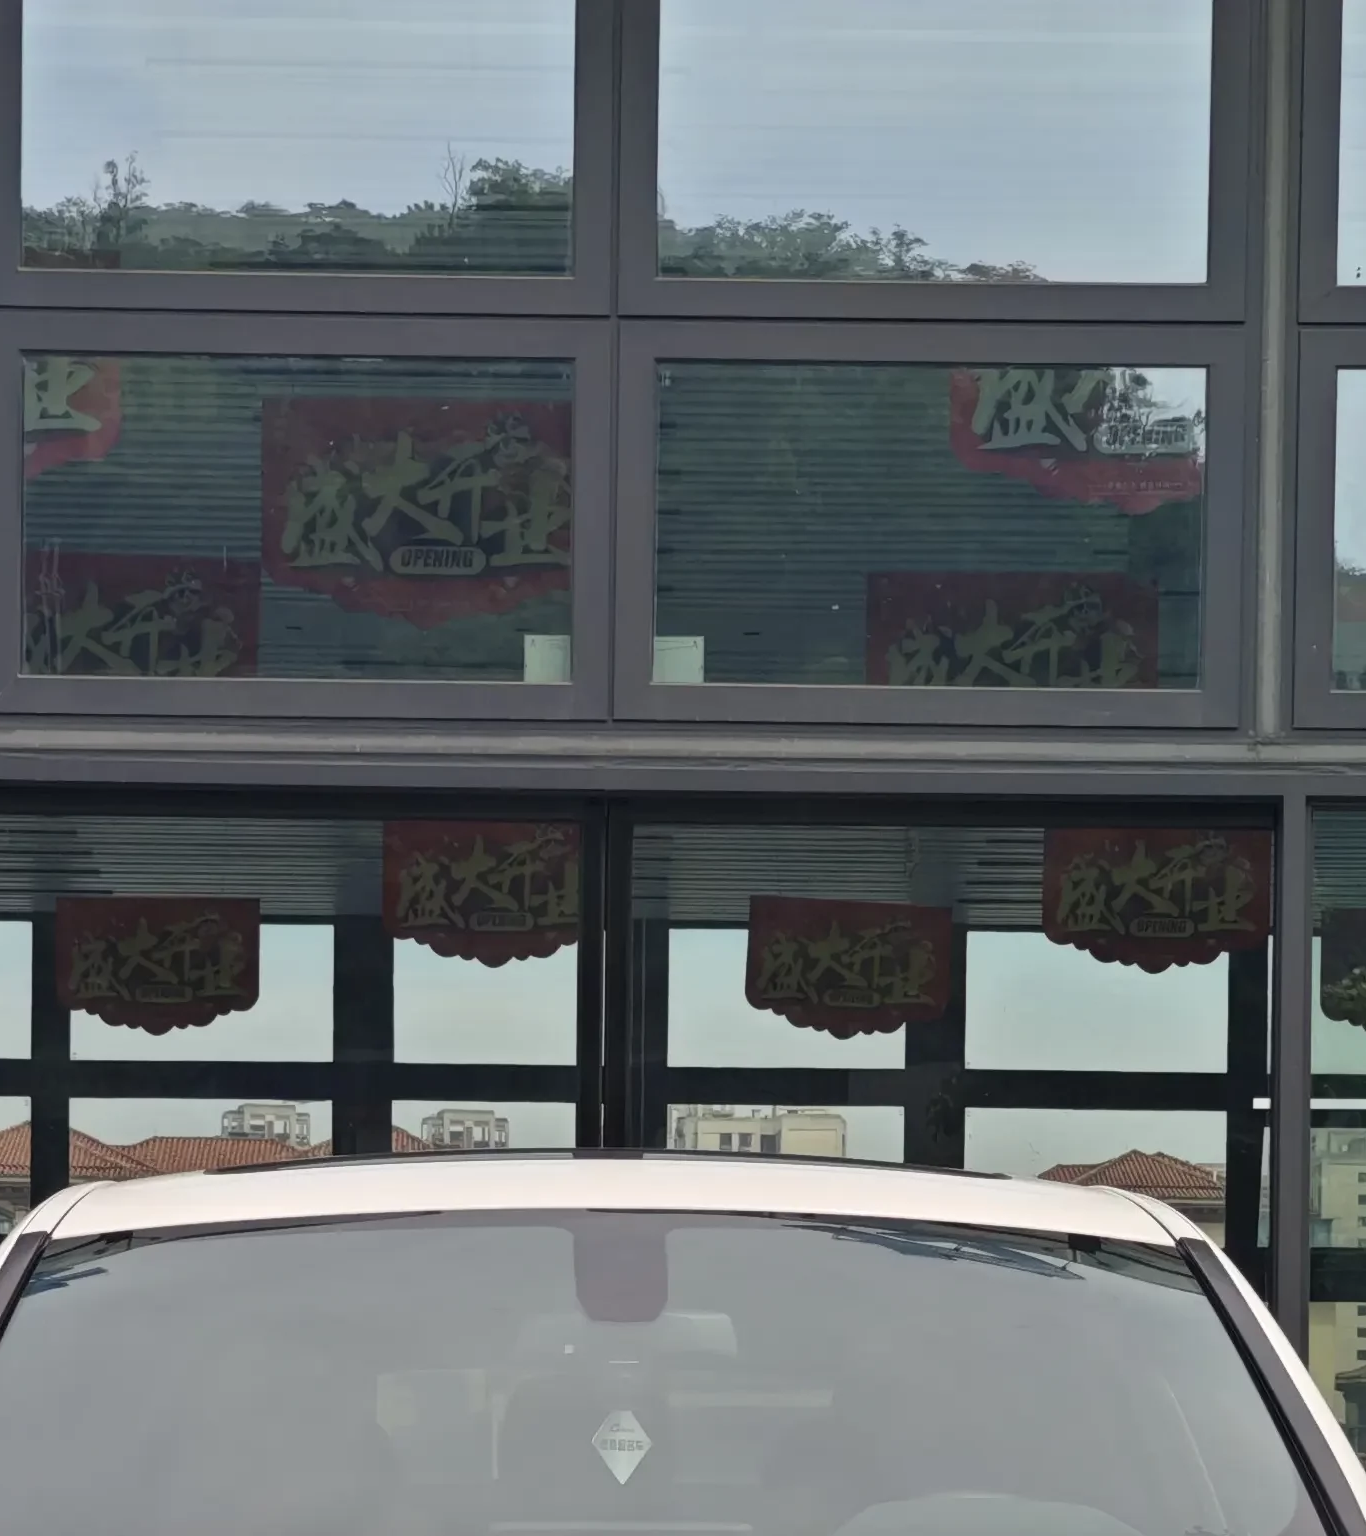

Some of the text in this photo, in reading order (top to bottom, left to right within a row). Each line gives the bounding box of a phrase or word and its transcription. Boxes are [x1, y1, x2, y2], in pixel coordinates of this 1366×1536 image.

[280, 428, 572, 572] 盛大开业
[399, 546, 475, 569] OPENING
[1056, 838, 1258, 935] 盛大开业
